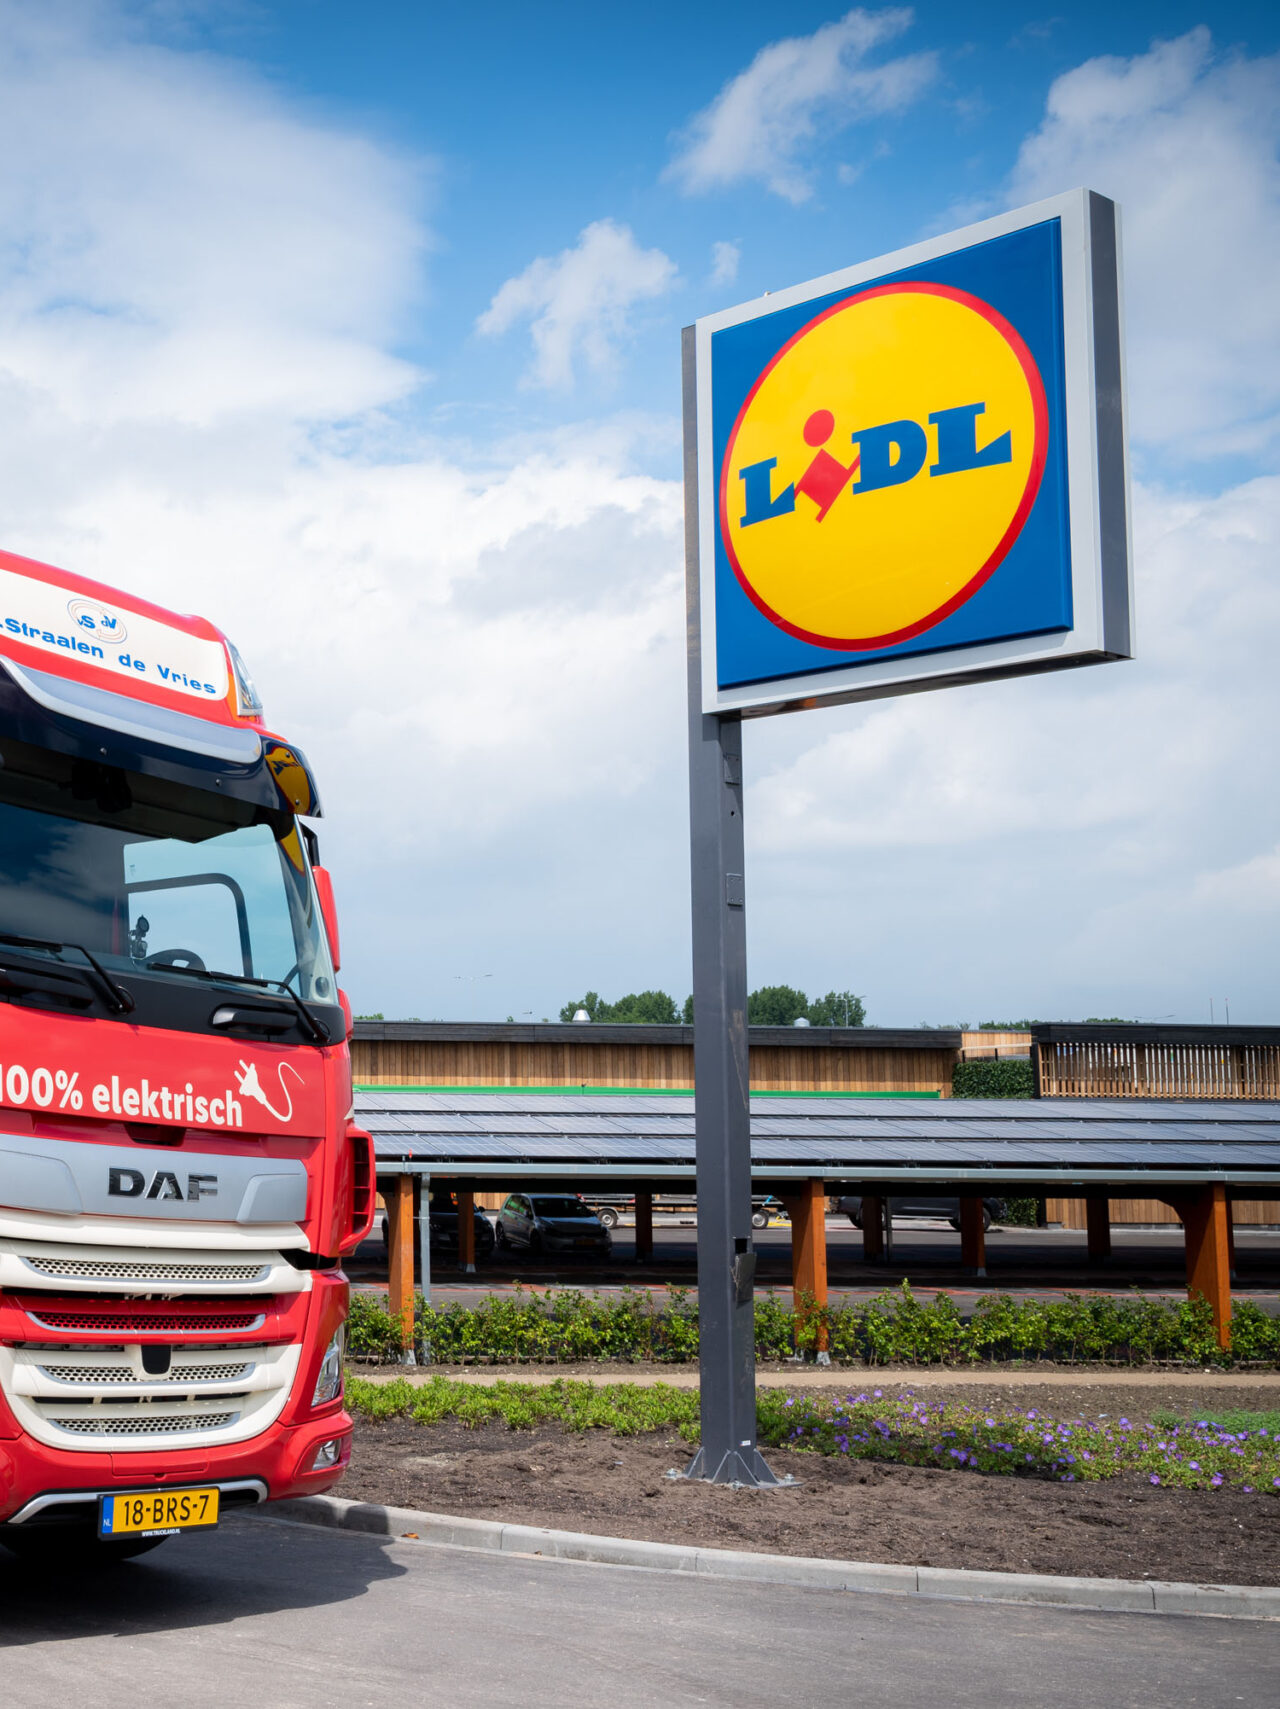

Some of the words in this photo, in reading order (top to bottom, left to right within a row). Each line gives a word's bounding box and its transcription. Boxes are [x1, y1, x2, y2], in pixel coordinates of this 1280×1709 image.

[118, 653, 146, 672] de
[157, 664, 216, 694] Vries
[92, 1075, 243, 1127] elektrisch
[108, 1167, 218, 1202] DAF
[103, 1518, 111, 1527] NL
[124, 1494, 210, 1526] 18-BRS-7
